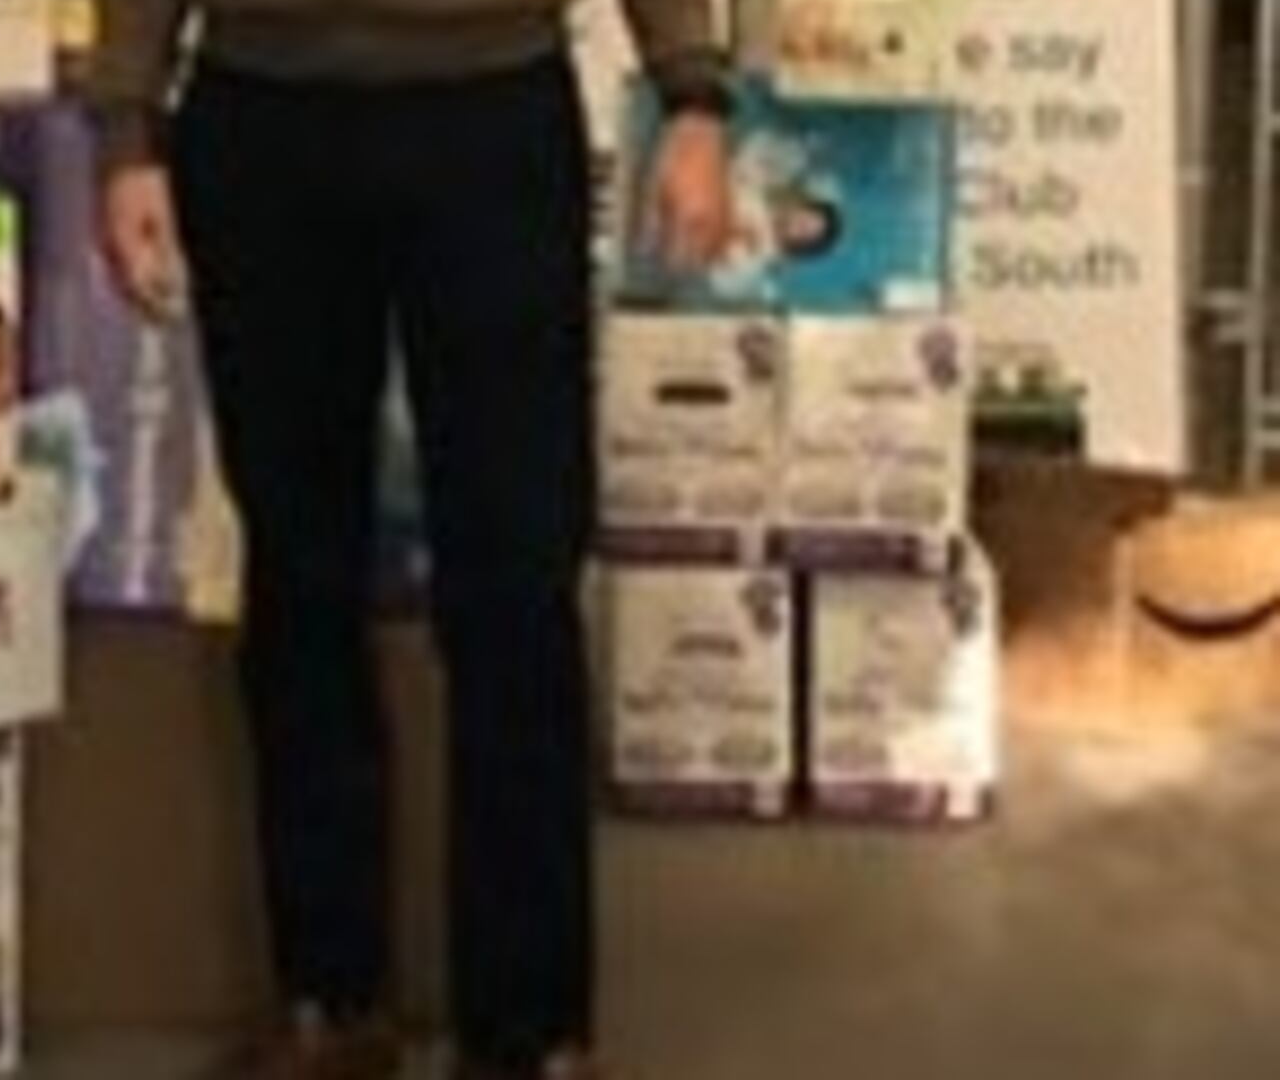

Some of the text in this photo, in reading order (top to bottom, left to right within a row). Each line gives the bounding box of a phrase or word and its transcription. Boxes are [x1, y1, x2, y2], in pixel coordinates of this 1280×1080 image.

[1007, 34, 1102, 81] say
[1032, 99, 1122, 144] the
[972, 240, 1140, 291] South
